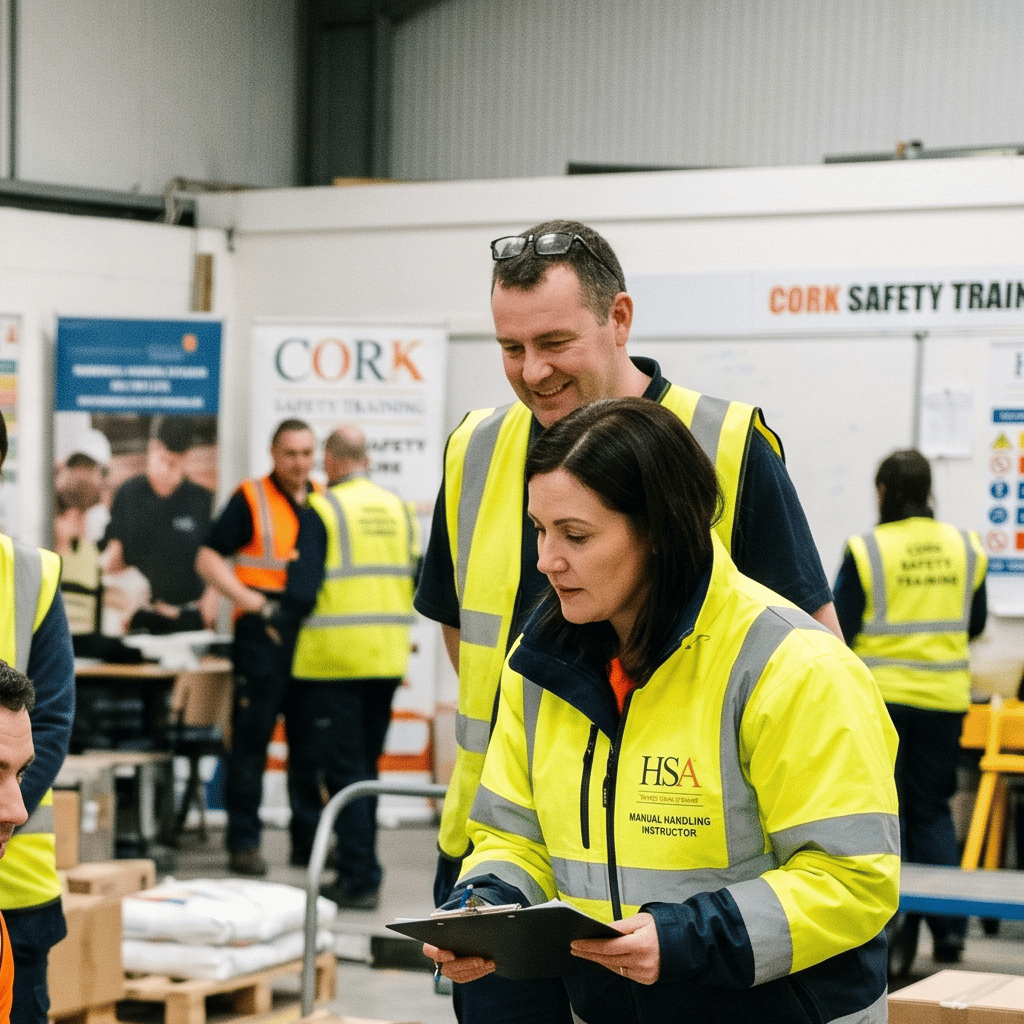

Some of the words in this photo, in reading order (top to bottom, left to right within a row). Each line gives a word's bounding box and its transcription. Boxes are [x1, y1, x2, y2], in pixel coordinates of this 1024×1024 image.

[769, 285, 841, 314] CORK
[848, 283, 943, 312] SAFETY
[274, 337, 423, 383] CORK
[639, 756, 702, 788] HSA
[629, 812, 662, 824] MANUAL
[641, 825, 697, 838] INSTRUCTOR
